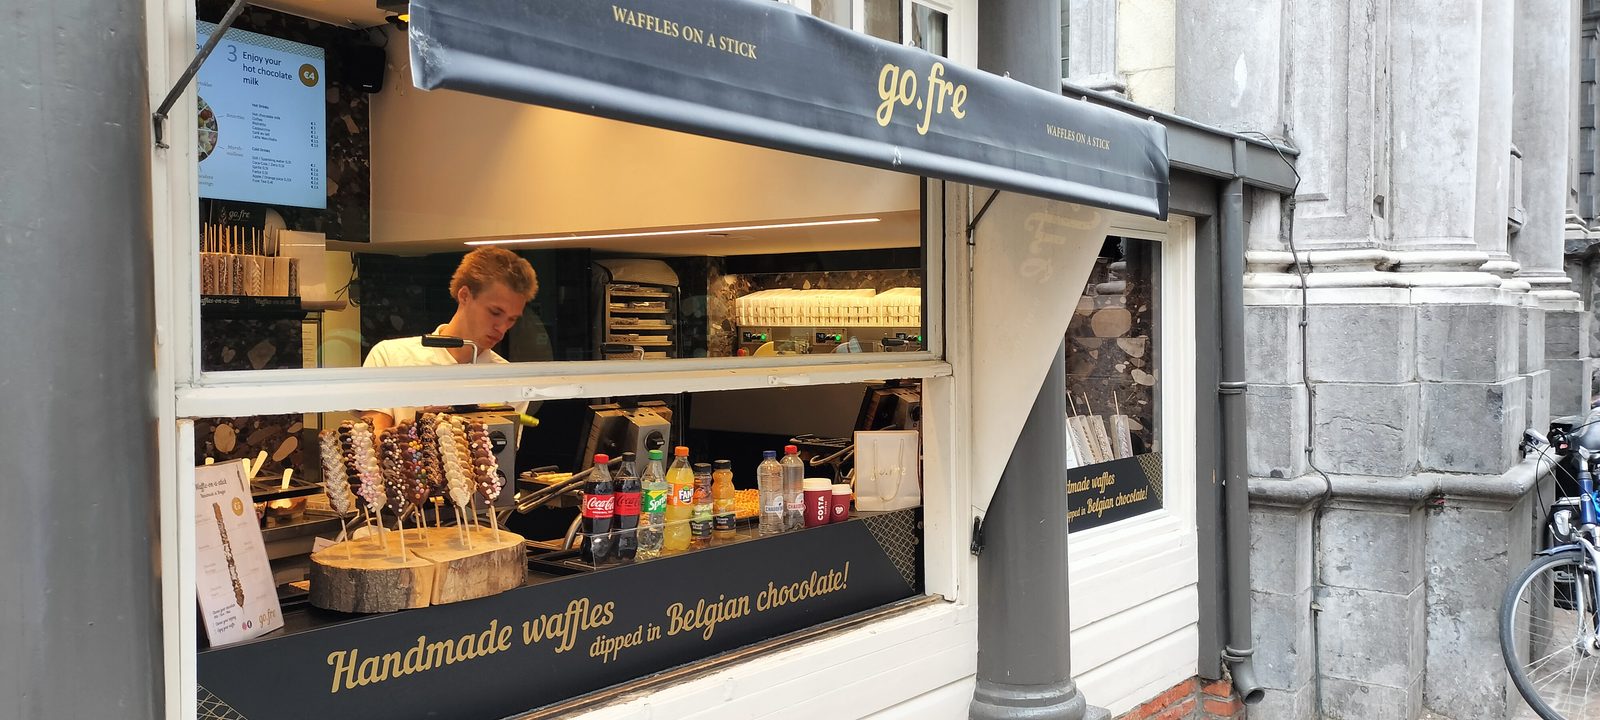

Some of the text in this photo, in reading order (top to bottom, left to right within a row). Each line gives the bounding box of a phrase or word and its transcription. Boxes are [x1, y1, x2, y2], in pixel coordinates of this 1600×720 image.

[612, 5, 757, 61] WAFFLES ON A STICK
[227, 44, 238, 62] 3
[242, 51, 282, 66] Enjoy your
[242, 63, 293, 81] hot chocolate
[242, 76, 259, 86] milk
[303, 71, 315, 81] €4
[876, 62, 968, 135] go.fre
[1046, 123, 1111, 150] WAFFLES ON A STICK
[1091, 471, 1115, 494] waffles
[817, 495, 825, 521] COSTA
[1086, 496, 1114, 519] Belgian
[1115, 485, 1149, 507] chocolate!
[588, 561, 850, 664] dipped in Belgian chocolate!
[327, 597, 616, 694] Handmade waffles
